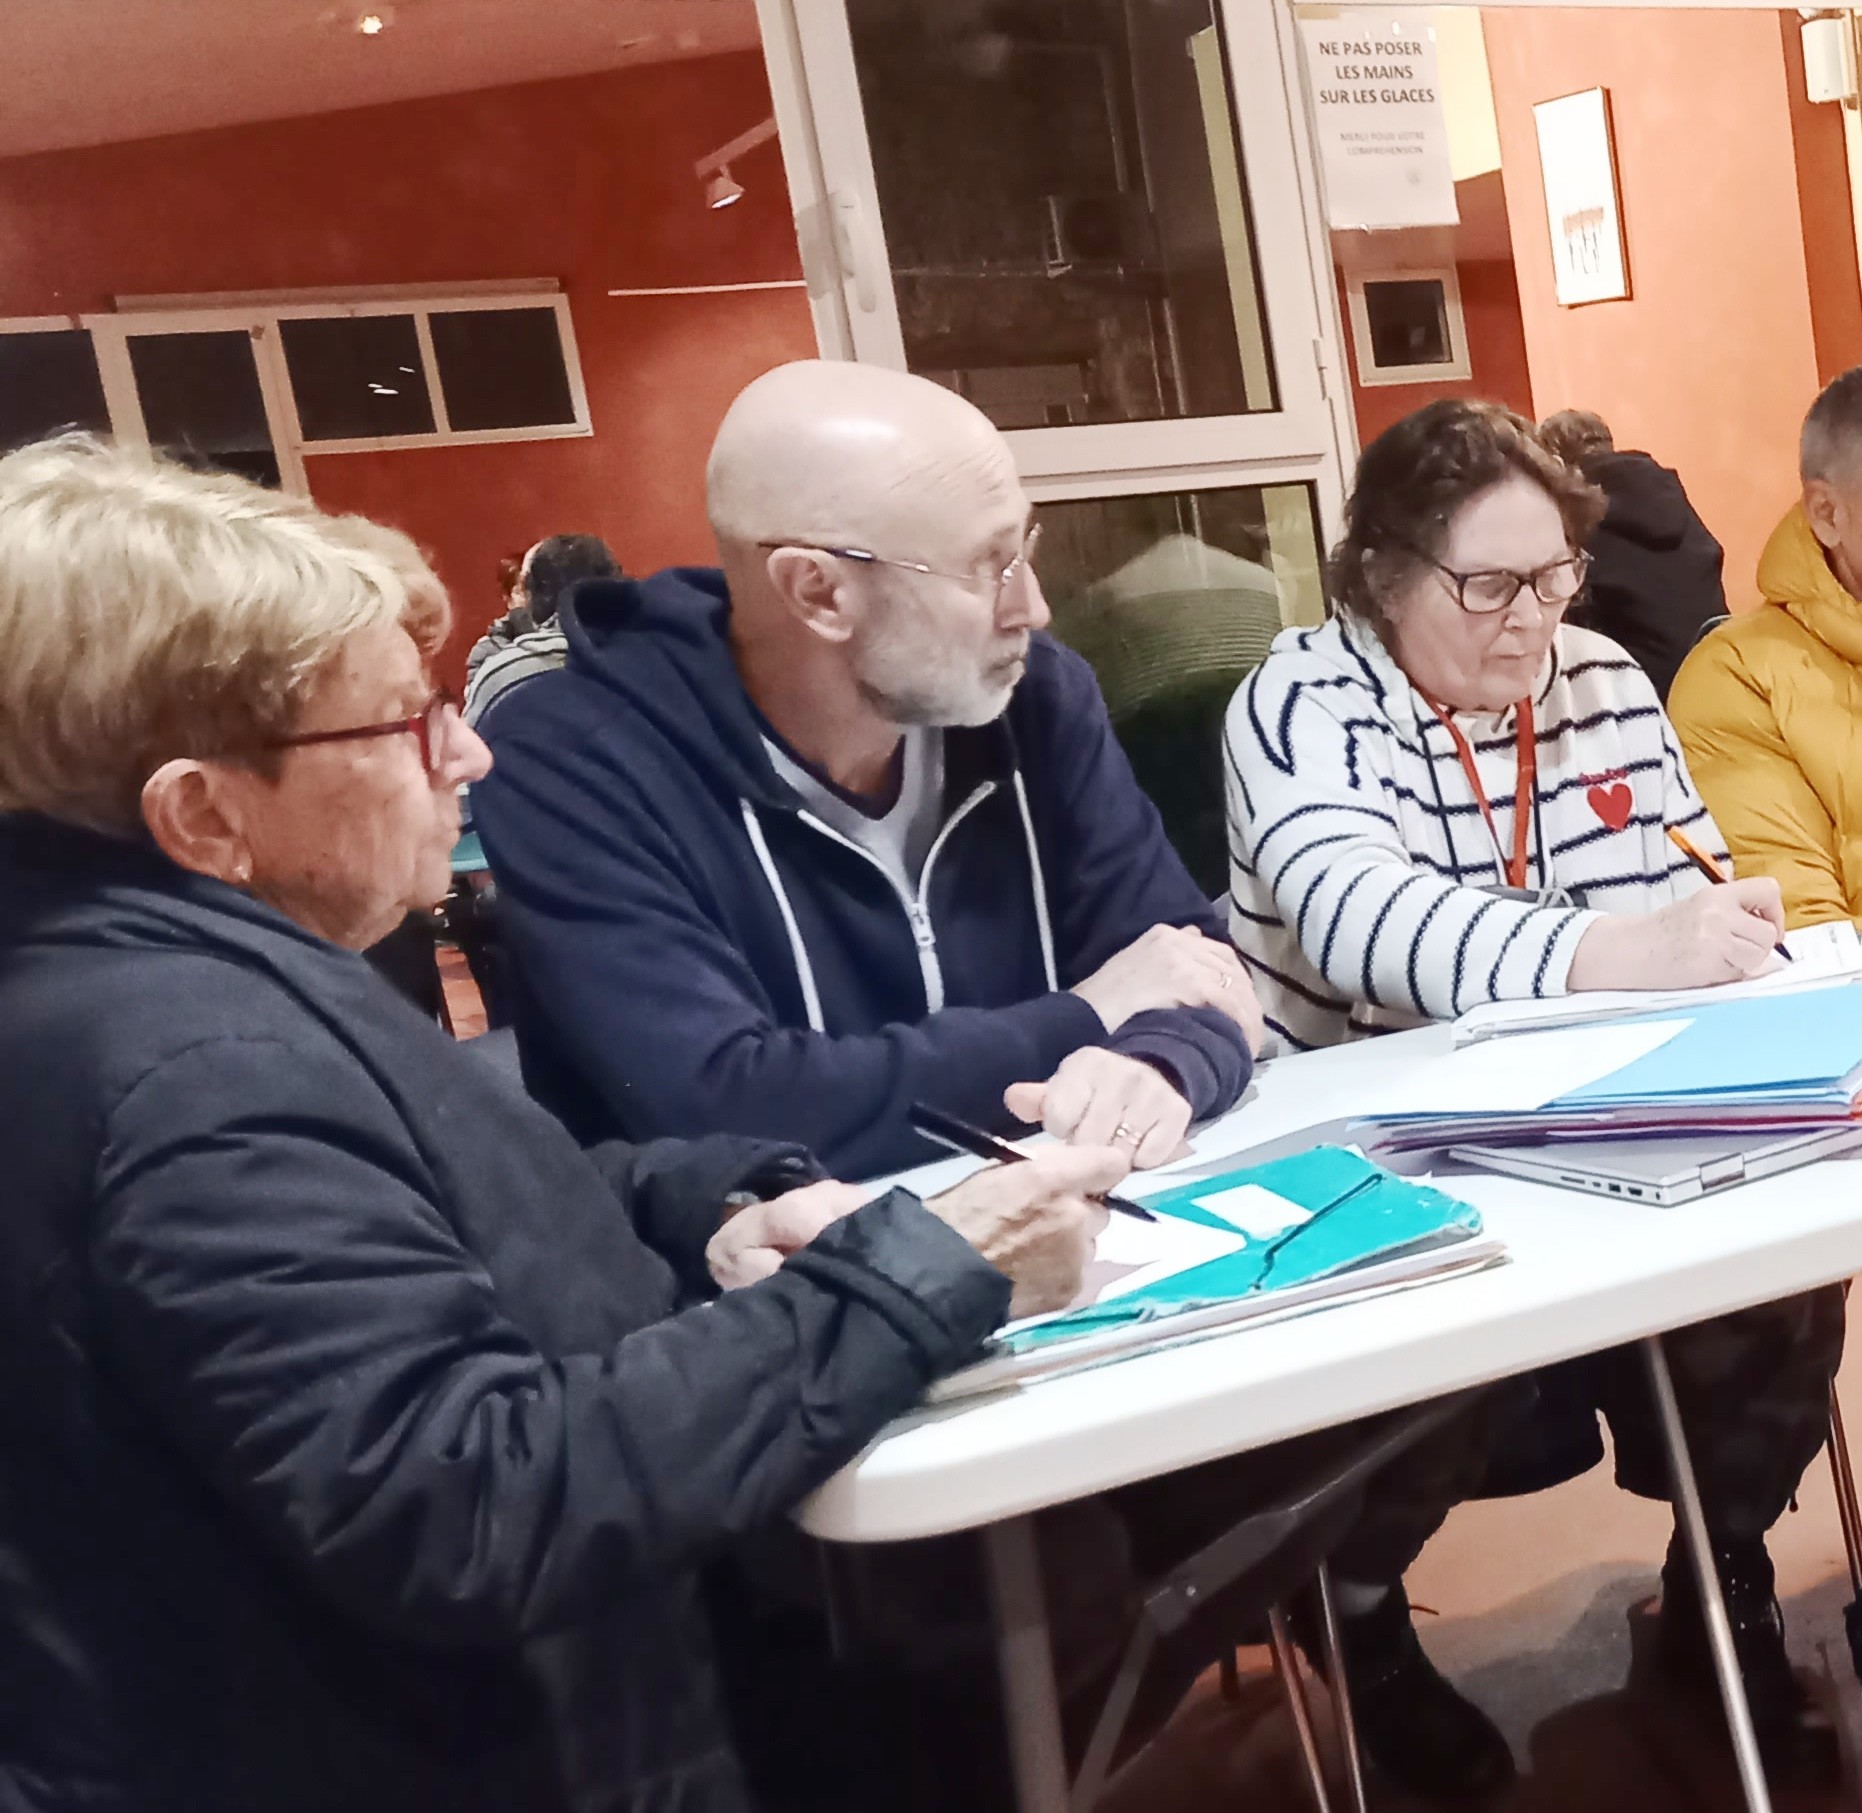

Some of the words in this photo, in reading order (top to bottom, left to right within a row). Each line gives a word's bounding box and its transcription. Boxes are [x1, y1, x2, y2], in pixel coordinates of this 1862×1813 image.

[1319, 42, 1339, 55] NE
[1343, 42, 1371, 55] PAS
[1375, 41, 1423, 55] POSER
[1335, 65, 1360, 79] LES
[1364, 65, 1413, 79] MAINS
[1320, 90, 1350, 104] SUR
[1353, 89, 1377, 103] LES
[1381, 88, 1435, 103] GLACES
